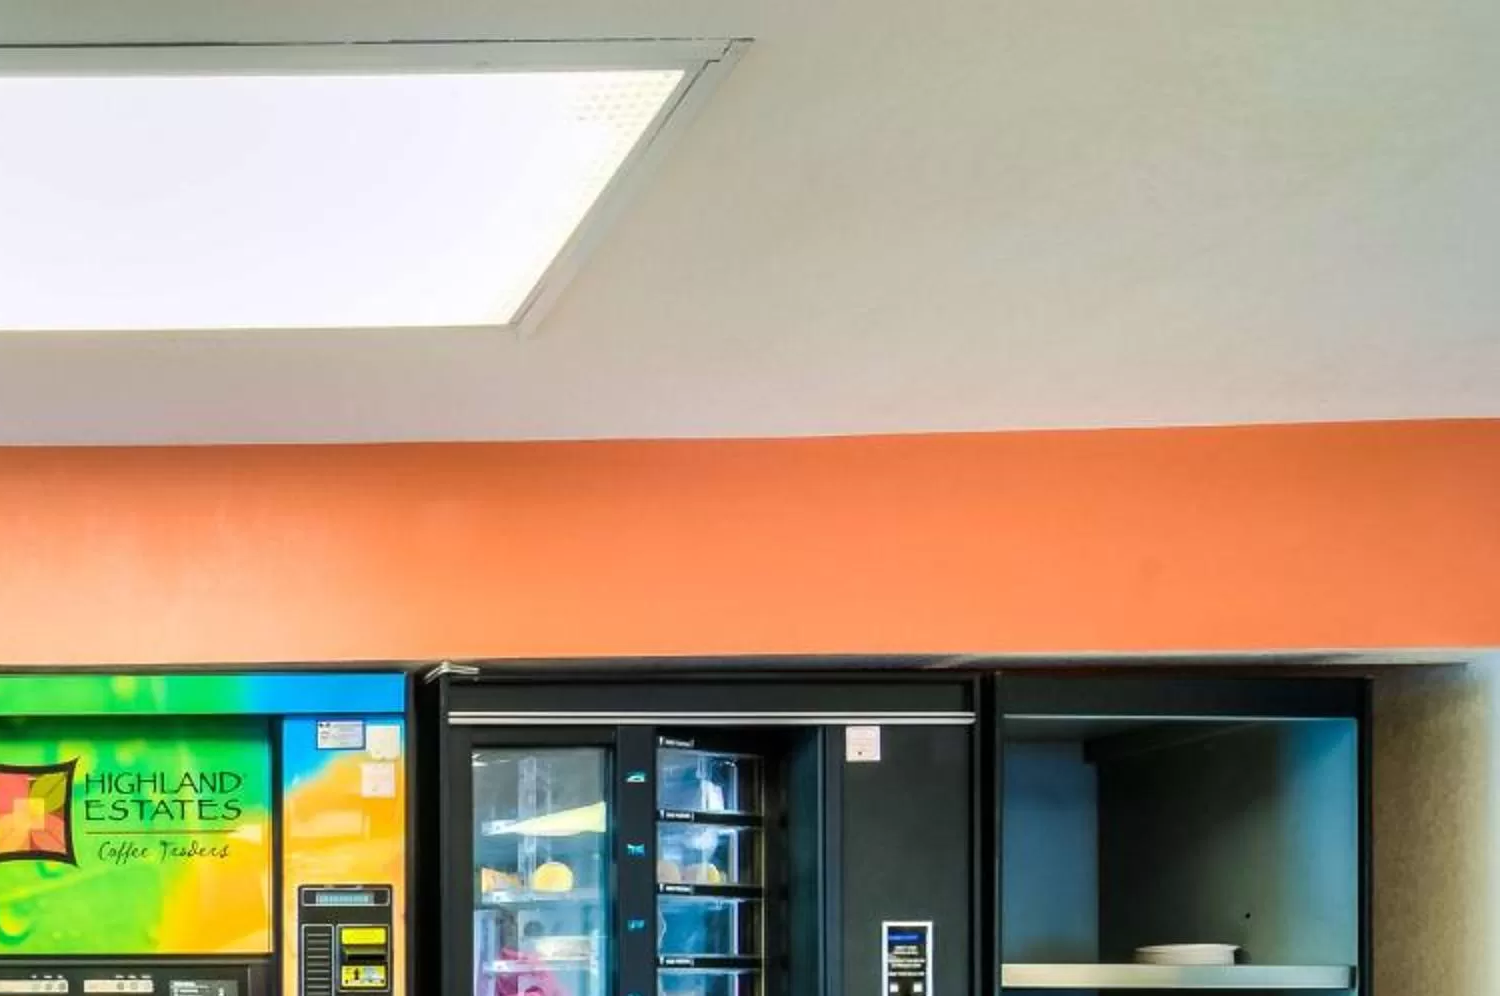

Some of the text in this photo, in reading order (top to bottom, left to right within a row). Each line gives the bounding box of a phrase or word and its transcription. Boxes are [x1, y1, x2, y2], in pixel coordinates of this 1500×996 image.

[84, 771, 241, 794] HIGHLAND
[85, 799, 242, 820] ESTATES
[98, 840, 149, 865] Coffee
